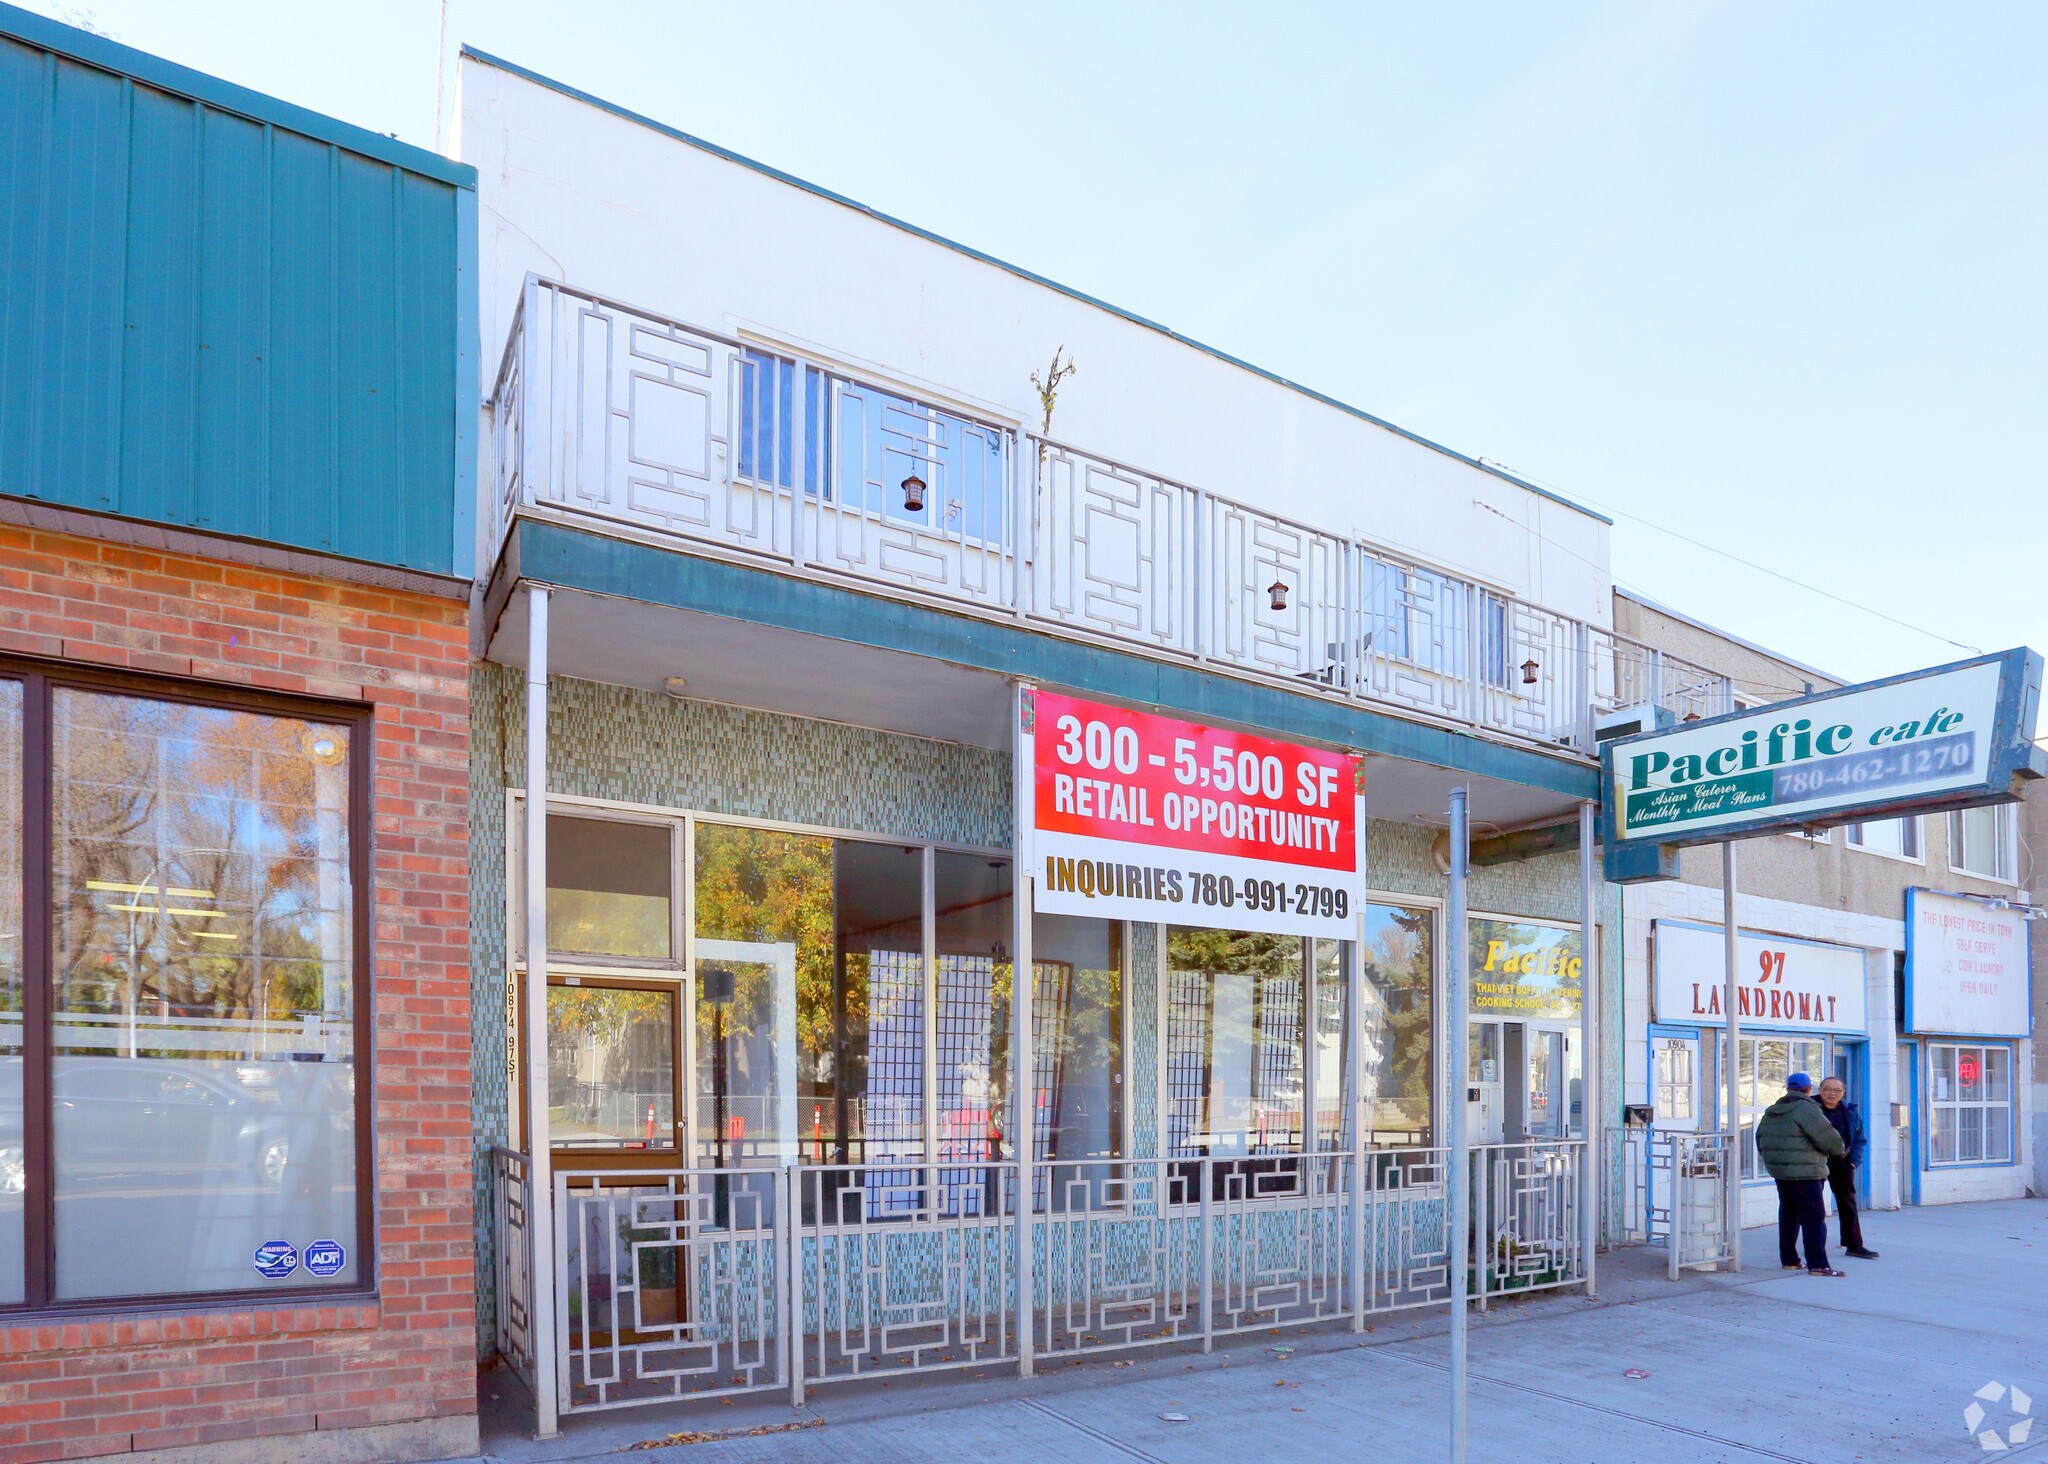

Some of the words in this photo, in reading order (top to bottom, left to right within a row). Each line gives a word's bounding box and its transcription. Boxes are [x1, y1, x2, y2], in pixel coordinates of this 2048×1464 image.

[1056, 714, 1139, 775] 300
[1173, 737, 1284, 800] 5,500
[1296, 761, 1338, 808] SF
[1628, 718, 1853, 791] Pacific
[1869, 707, 1964, 746] cafe
[1778, 743, 1971, 796] 780-462-1270
[1629, 804, 1681, 823] Monthly
[1687, 796, 1724, 813] Meal
[1730, 791, 1766, 806] Plans
[1651, 791, 1687, 806] Asian
[1694, 783, 1737, 798] Caterer
[1055, 773, 1154, 826] RETAIL
[1163, 792, 1340, 853] OPPORTUNITY
[1046, 856, 1183, 903] INQUIRIES
[1188, 872, 1348, 919] 780-991-2799
[1923, 911, 1936, 926] THE
[1939, 913, 1965, 930] LOWEST
[1967, 919, 1986, 934] PRICE
[1988, 922, 1996, 934] IN
[1997, 923, 2013, 938] TOWN
[1483, 940, 1582, 979] Pacific
[1956, 938, 1972, 952] SELF
[1974, 941, 1996, 955] SERVE
[1758, 950, 1786, 984] 97
[1958, 959, 1972, 972] COIN
[1974, 960, 2004, 977] LAUNDRY
[1476, 997, 1513, 1008] COOKING
[1514, 998, 1545, 1009] SCHOOL
[1692, 983, 1836, 1023] LANDROMAT
[1959, 980, 1977, 994] OPEN
[1979, 982, 1998, 995] DAILY
[1667, 1038, 1686, 1050] 10904
[311, 1252, 339, 1265] ADT
